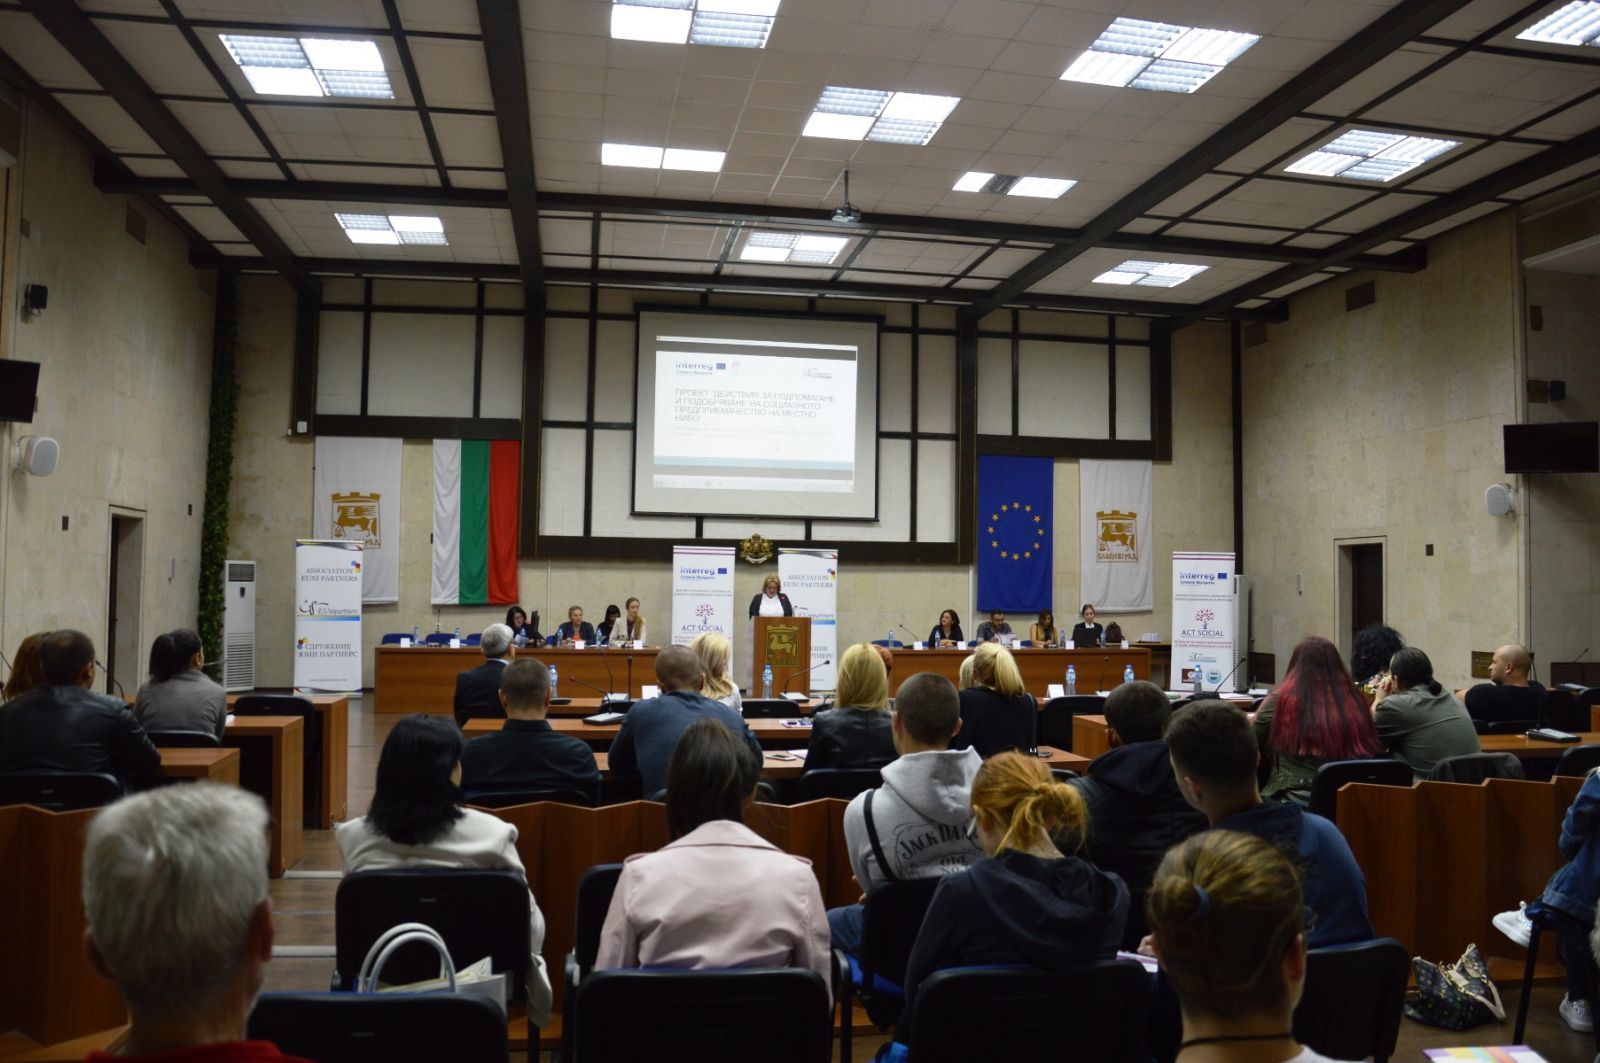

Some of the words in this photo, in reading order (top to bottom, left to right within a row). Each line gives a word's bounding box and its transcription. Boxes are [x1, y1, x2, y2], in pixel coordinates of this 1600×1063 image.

[675, 388, 709, 398] ПРОЕКТ
[750, 400, 762, 408] НА
[769, 408, 781, 417] НА
[305, 567, 353, 575] ASSOCIATION
[301, 574, 319, 582] EUNI
[320, 575, 358, 583] PARTNERS
[787, 574, 829, 582] ASSOCIATION
[800, 582, 833, 590] PARTNERS
[681, 624, 697, 632] ACT
[697, 624, 724, 633] SOCIAL
[1197, 629, 1224, 637] SOCIAL
[900, 832, 939, 860] JACK
